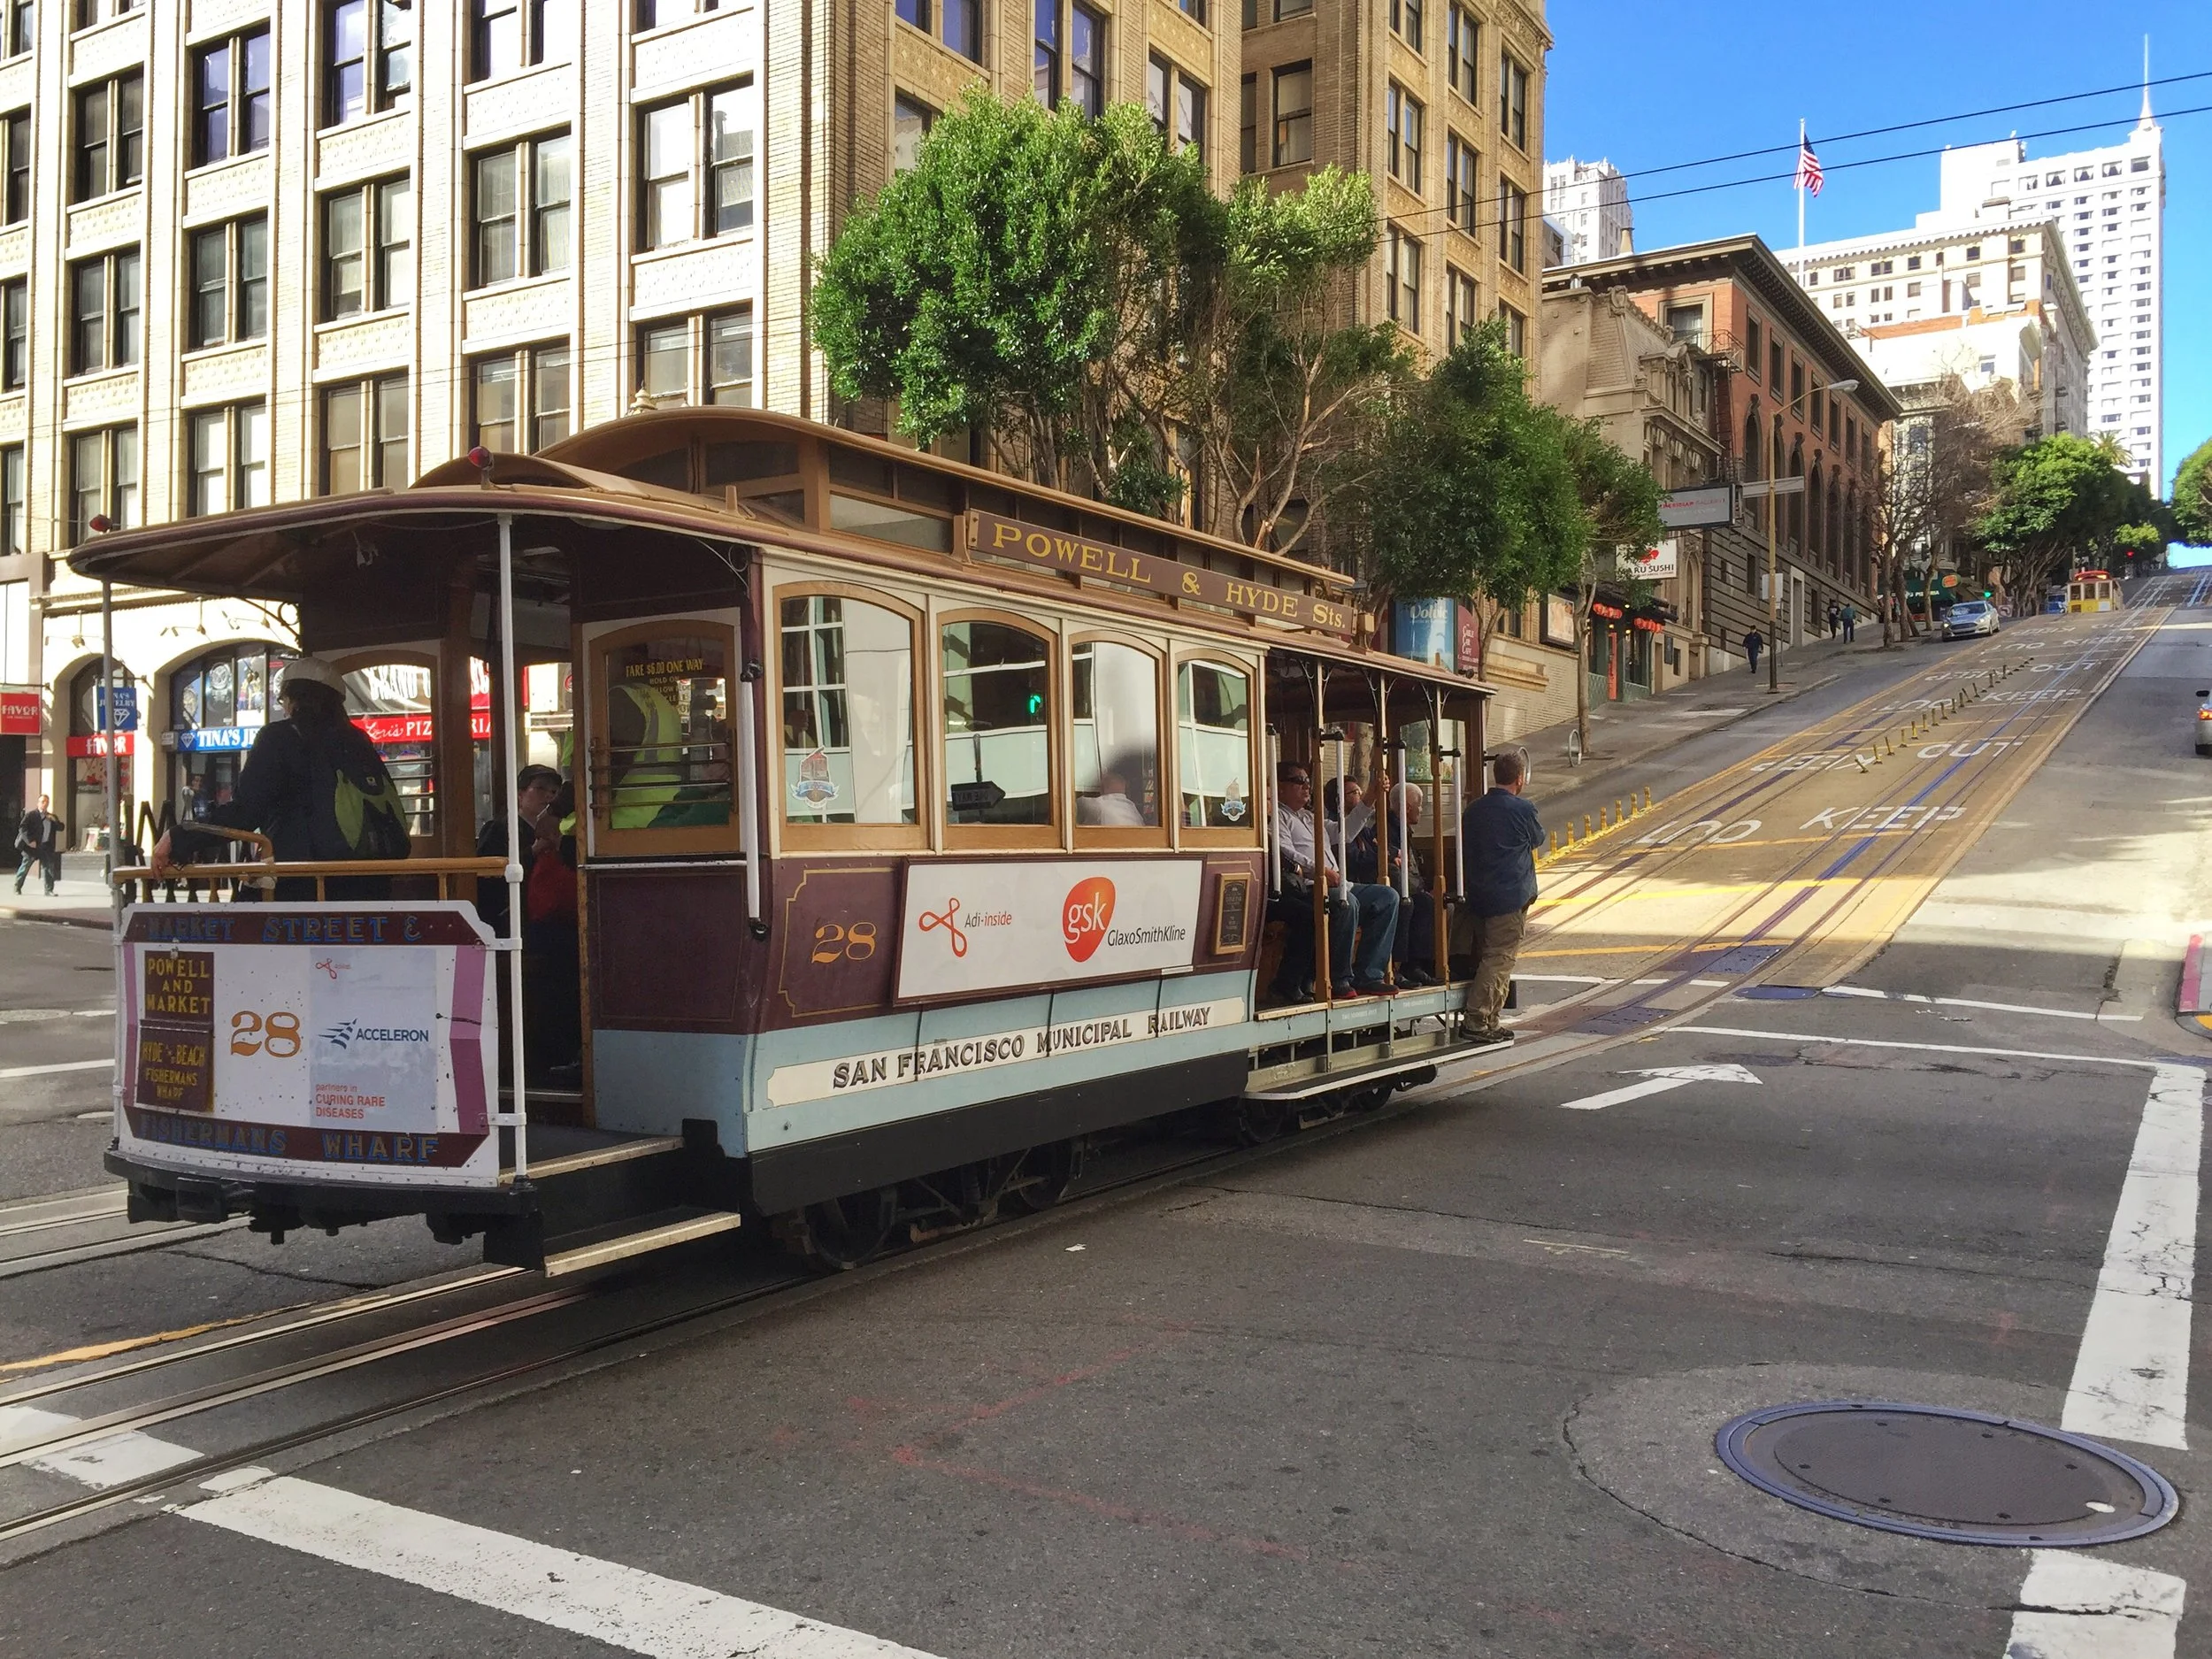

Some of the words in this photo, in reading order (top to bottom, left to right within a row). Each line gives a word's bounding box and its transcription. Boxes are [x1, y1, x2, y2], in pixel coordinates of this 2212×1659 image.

[993, 522, 1150, 584] POWELL
[1181, 572, 1202, 595] &
[1225, 581, 1298, 618] HYDE
[1313, 604, 1345, 629] Sts.
[1648, 564, 1674, 572] SUSHI
[666, 660, 684, 673] ONE
[686, 657, 704, 671] WAY
[2030, 658, 2102, 672] OUT
[1980, 688, 2081, 703] KEEP
[197, 729, 240, 748] TINA'S
[1916, 734, 2027, 759] OUT
[1799, 805, 1967, 830] KEEP
[964, 911, 1012, 928] Adi-inside
[1064, 891, 1105, 944] gsk
[263, 916, 388, 942] STREET
[1107, 926, 1187, 948] GlaxoSmithKline
[810, 921, 876, 964] 28
[148, 958, 210, 979] POWELL
[162, 979, 193, 994] AND
[146, 994, 211, 1014] MARKET
[230, 1010, 302, 1058] 28
[356, 1027, 429, 1042] ACCELERON
[833, 1056, 887, 1089] SAN
[896, 1033, 1025, 1078] FRANCISCO
[1037, 1018, 1133, 1053] MUNICIPAL
[1148, 1007, 1211, 1035] RAILWAY
[316, 1083, 348, 1093] partners
[316, 1094, 354, 1106] CURING
[357, 1095, 385, 1107] RARE
[316, 1108, 365, 1119] DISEASES
[320, 1131, 439, 1164] WHARF
